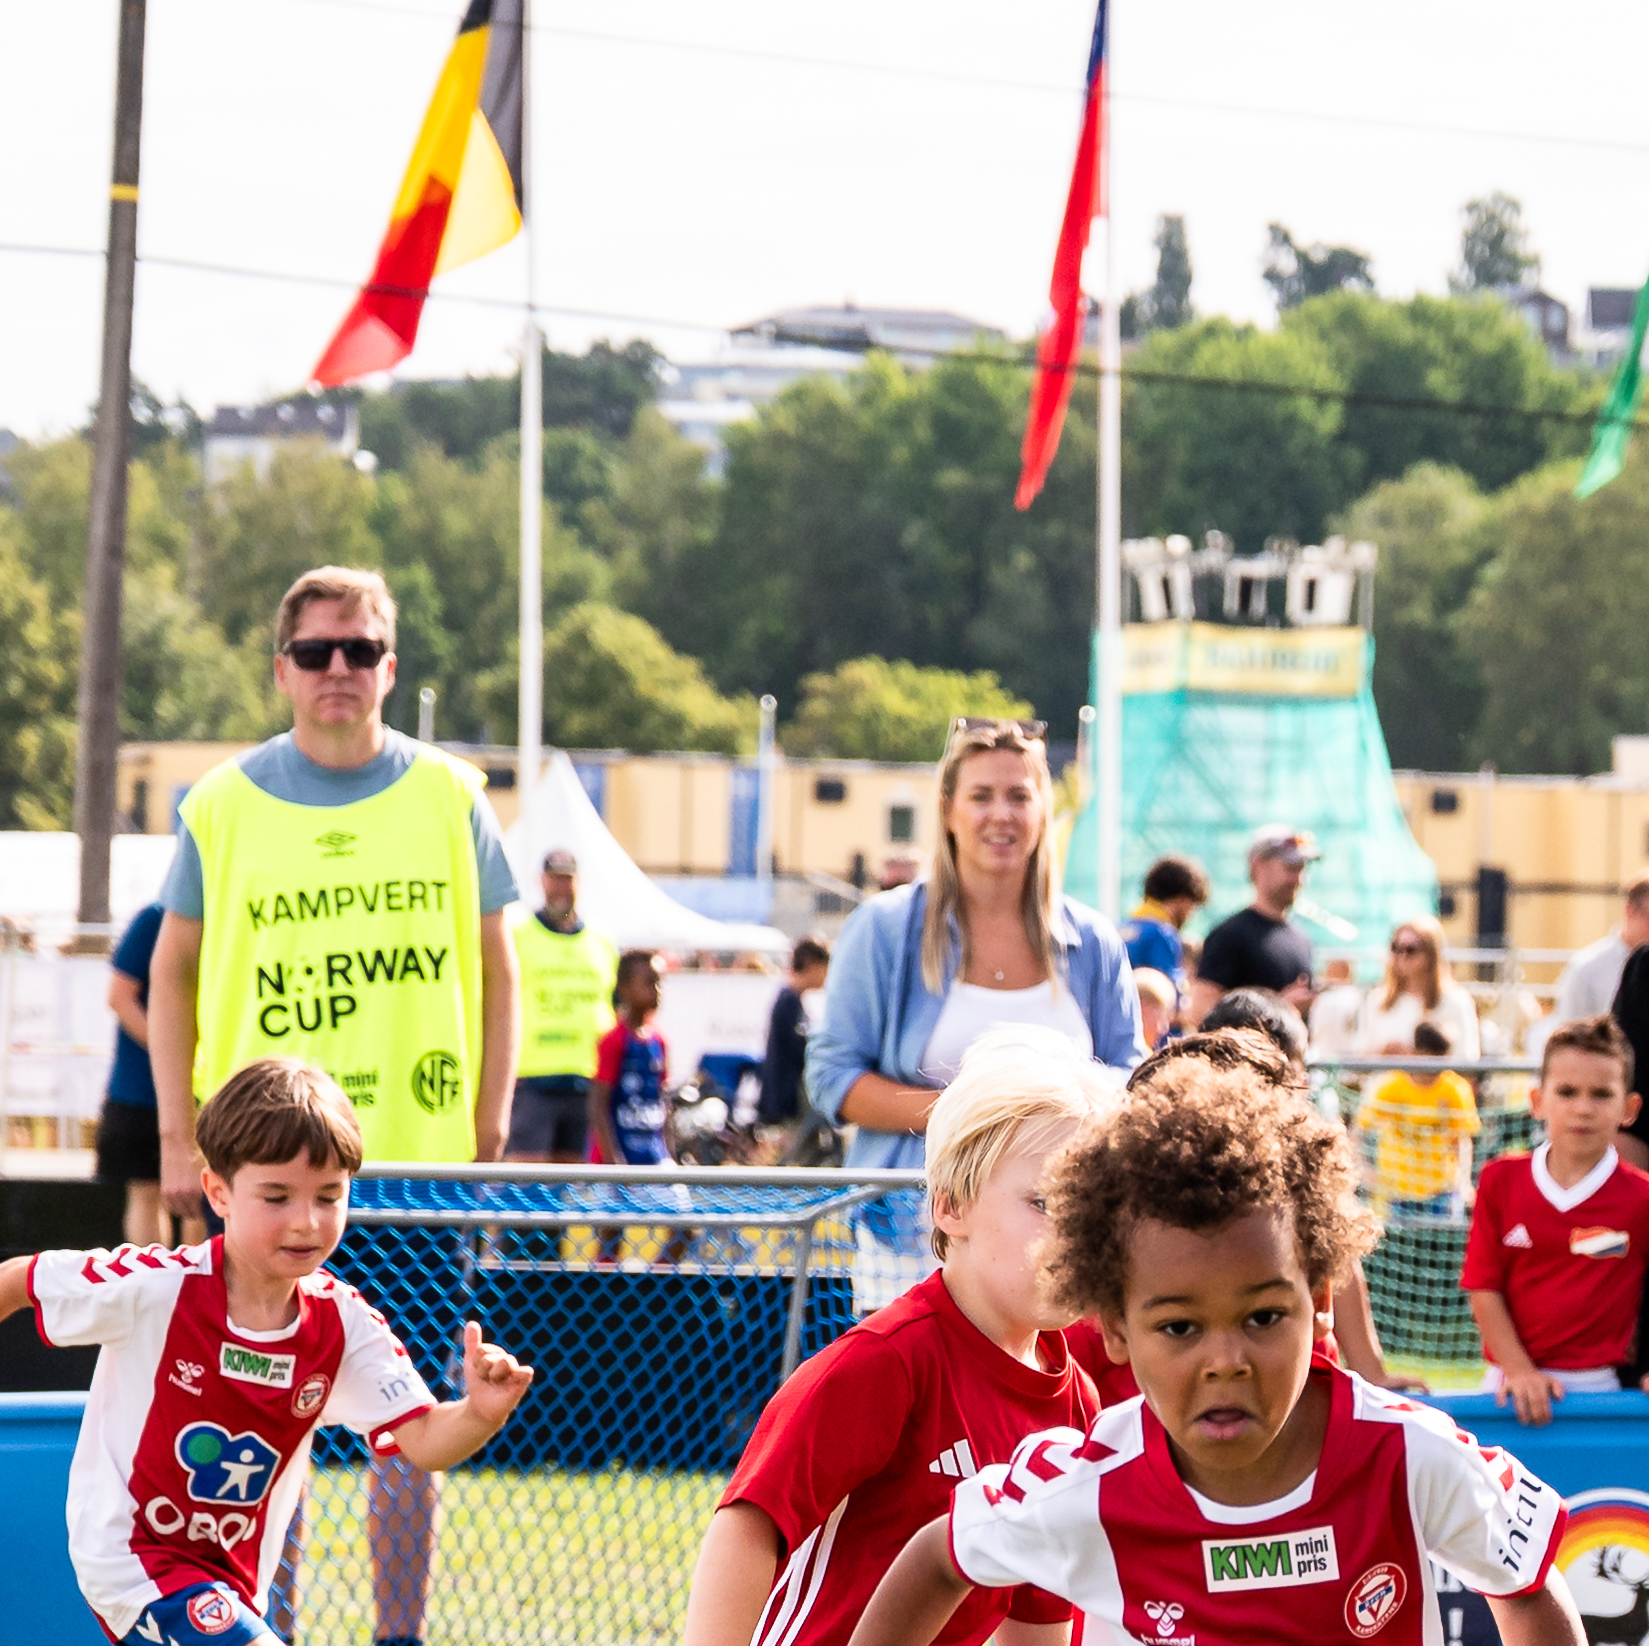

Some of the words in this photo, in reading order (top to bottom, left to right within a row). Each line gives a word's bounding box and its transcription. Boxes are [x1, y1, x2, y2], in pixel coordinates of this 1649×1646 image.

[247, 879, 448, 932] KAMPVERT
[259, 994, 357, 1038] CUP
[224, 1348, 272, 1378] KIWI
[1210, 1541, 1293, 1581] KIWI
[1295, 1534, 1329, 1557] mini
[1297, 1555, 1328, 1578] pris
